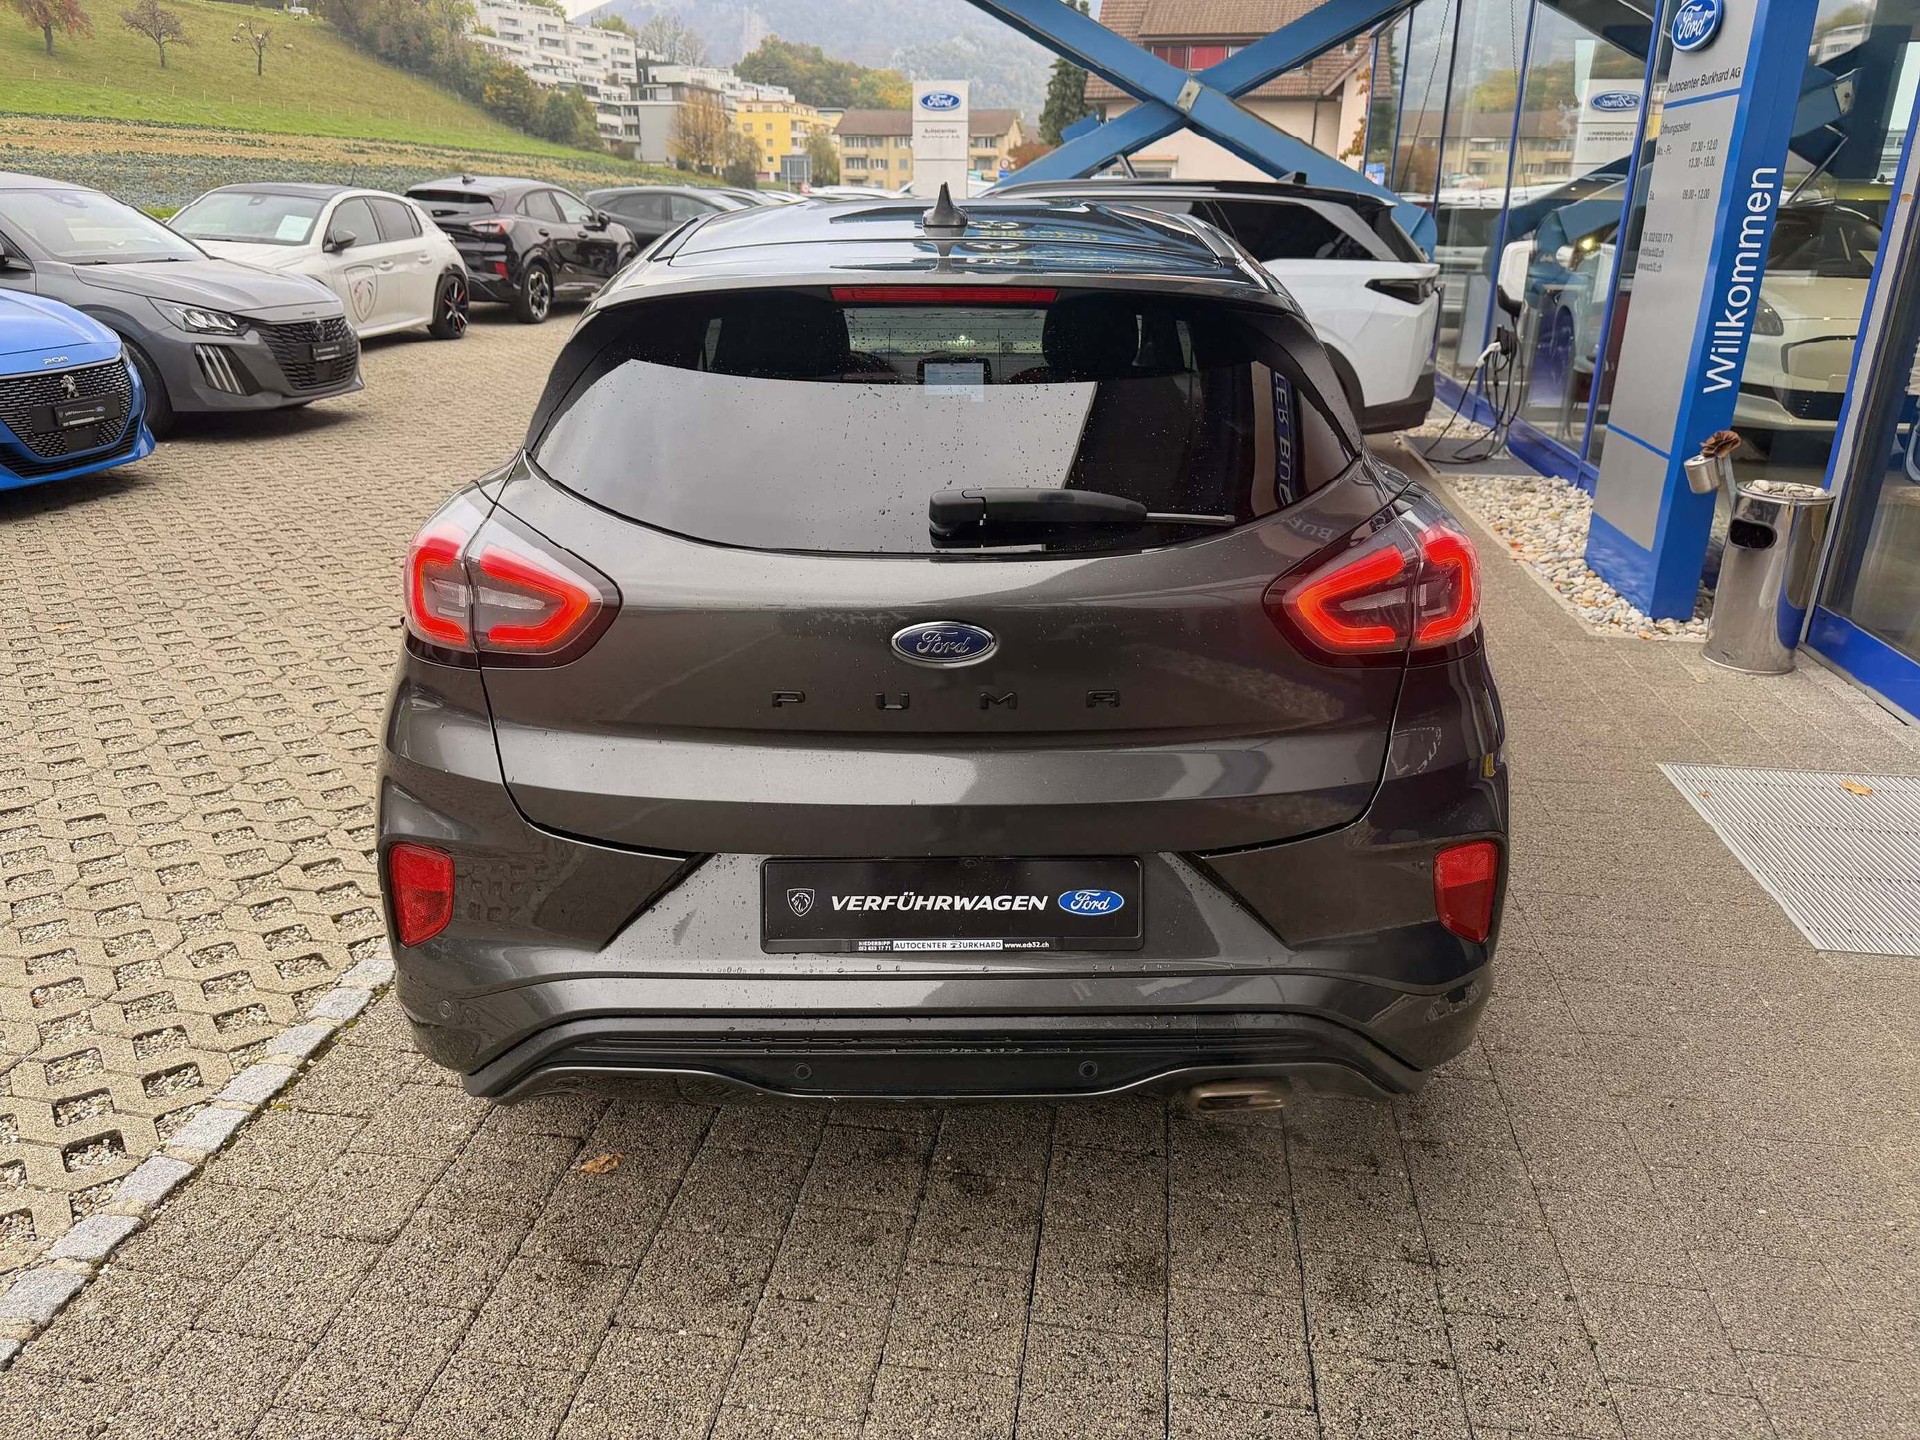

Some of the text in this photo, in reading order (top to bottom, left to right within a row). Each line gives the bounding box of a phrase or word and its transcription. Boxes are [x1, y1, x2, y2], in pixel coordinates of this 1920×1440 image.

[1667, 66, 1742, 94] Autocenter Burkhard AG
[1703, 167, 1777, 393] Willkommen
[916, 630, 970, 655] Ford
[831, 890, 1110, 912] VERFÜHRWAGEN Ford
